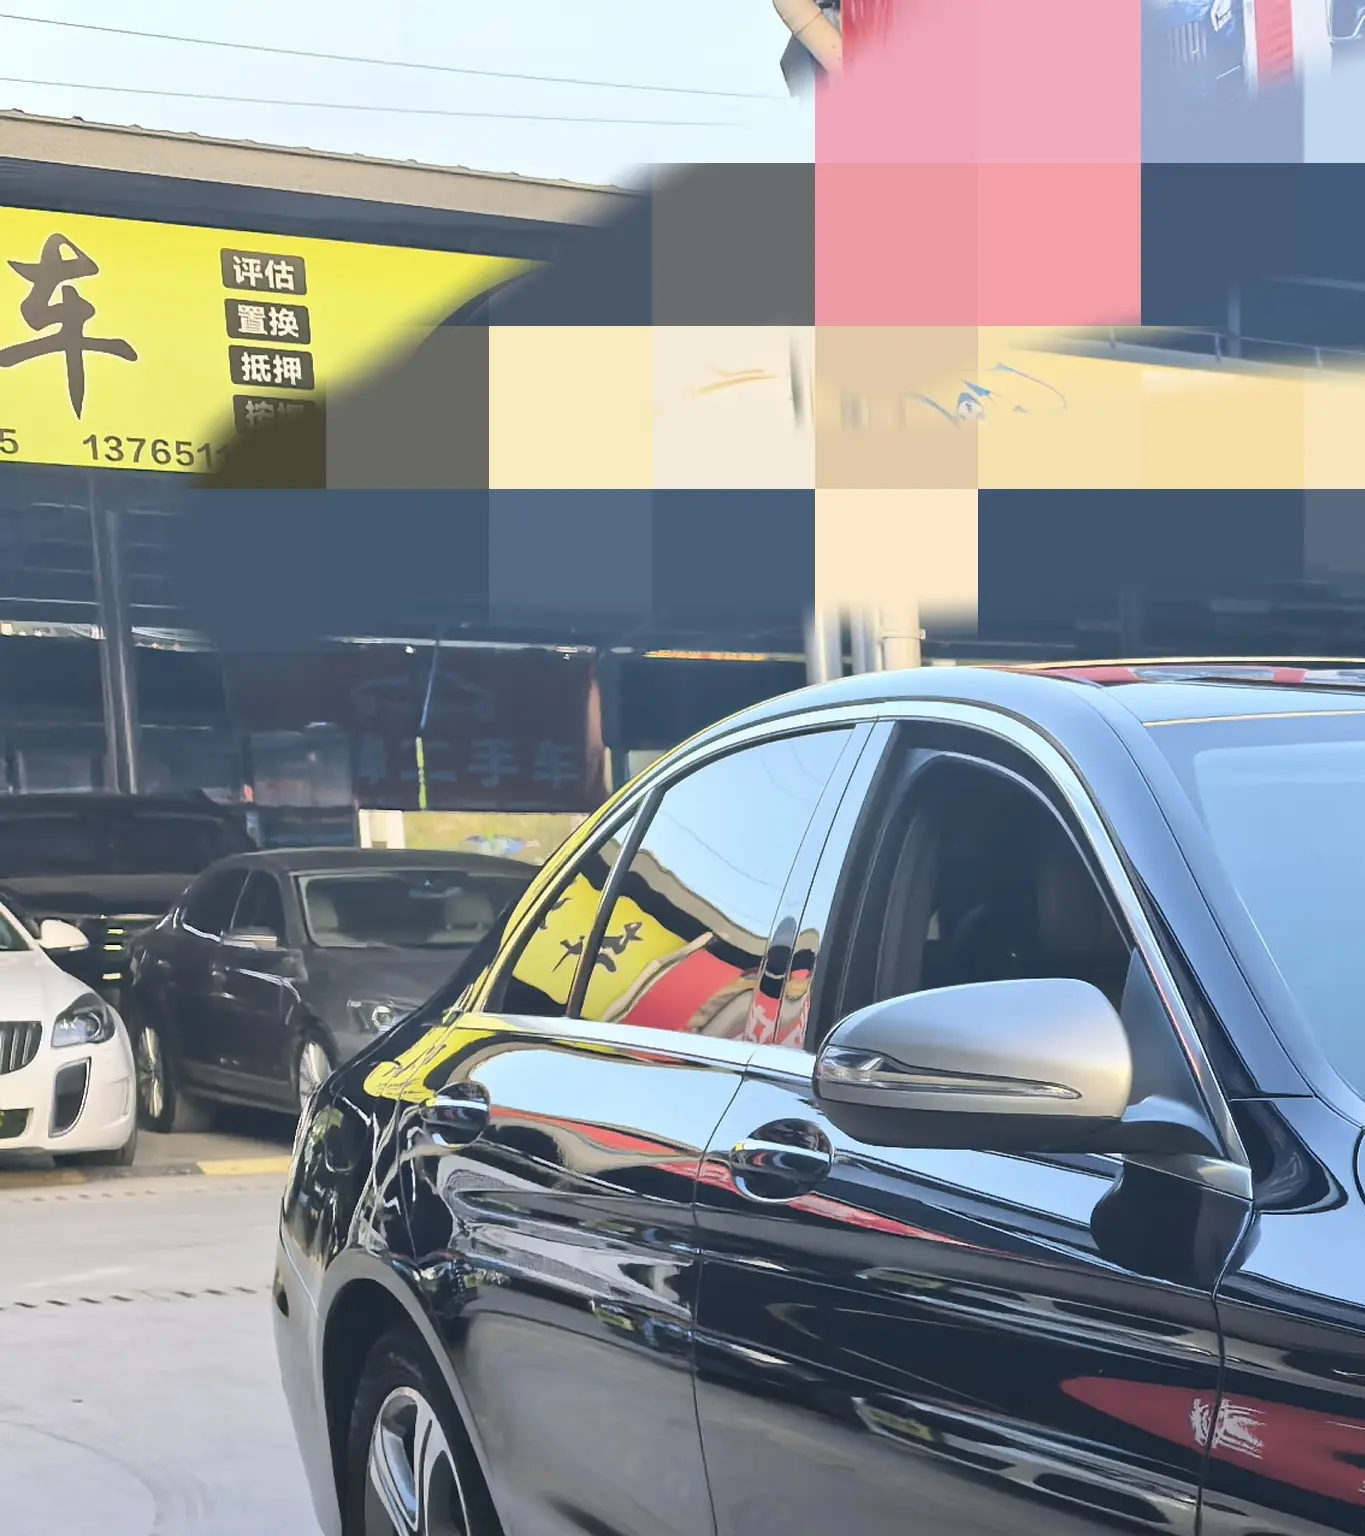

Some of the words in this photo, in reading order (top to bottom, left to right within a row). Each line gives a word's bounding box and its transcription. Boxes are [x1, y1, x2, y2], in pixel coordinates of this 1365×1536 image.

[233, 256, 295, 291] 评估
[0, 233, 138, 421] 车
[237, 304, 299, 337] 置换
[241, 351, 302, 385] 抵押
[82, 433, 226, 469] 137651
